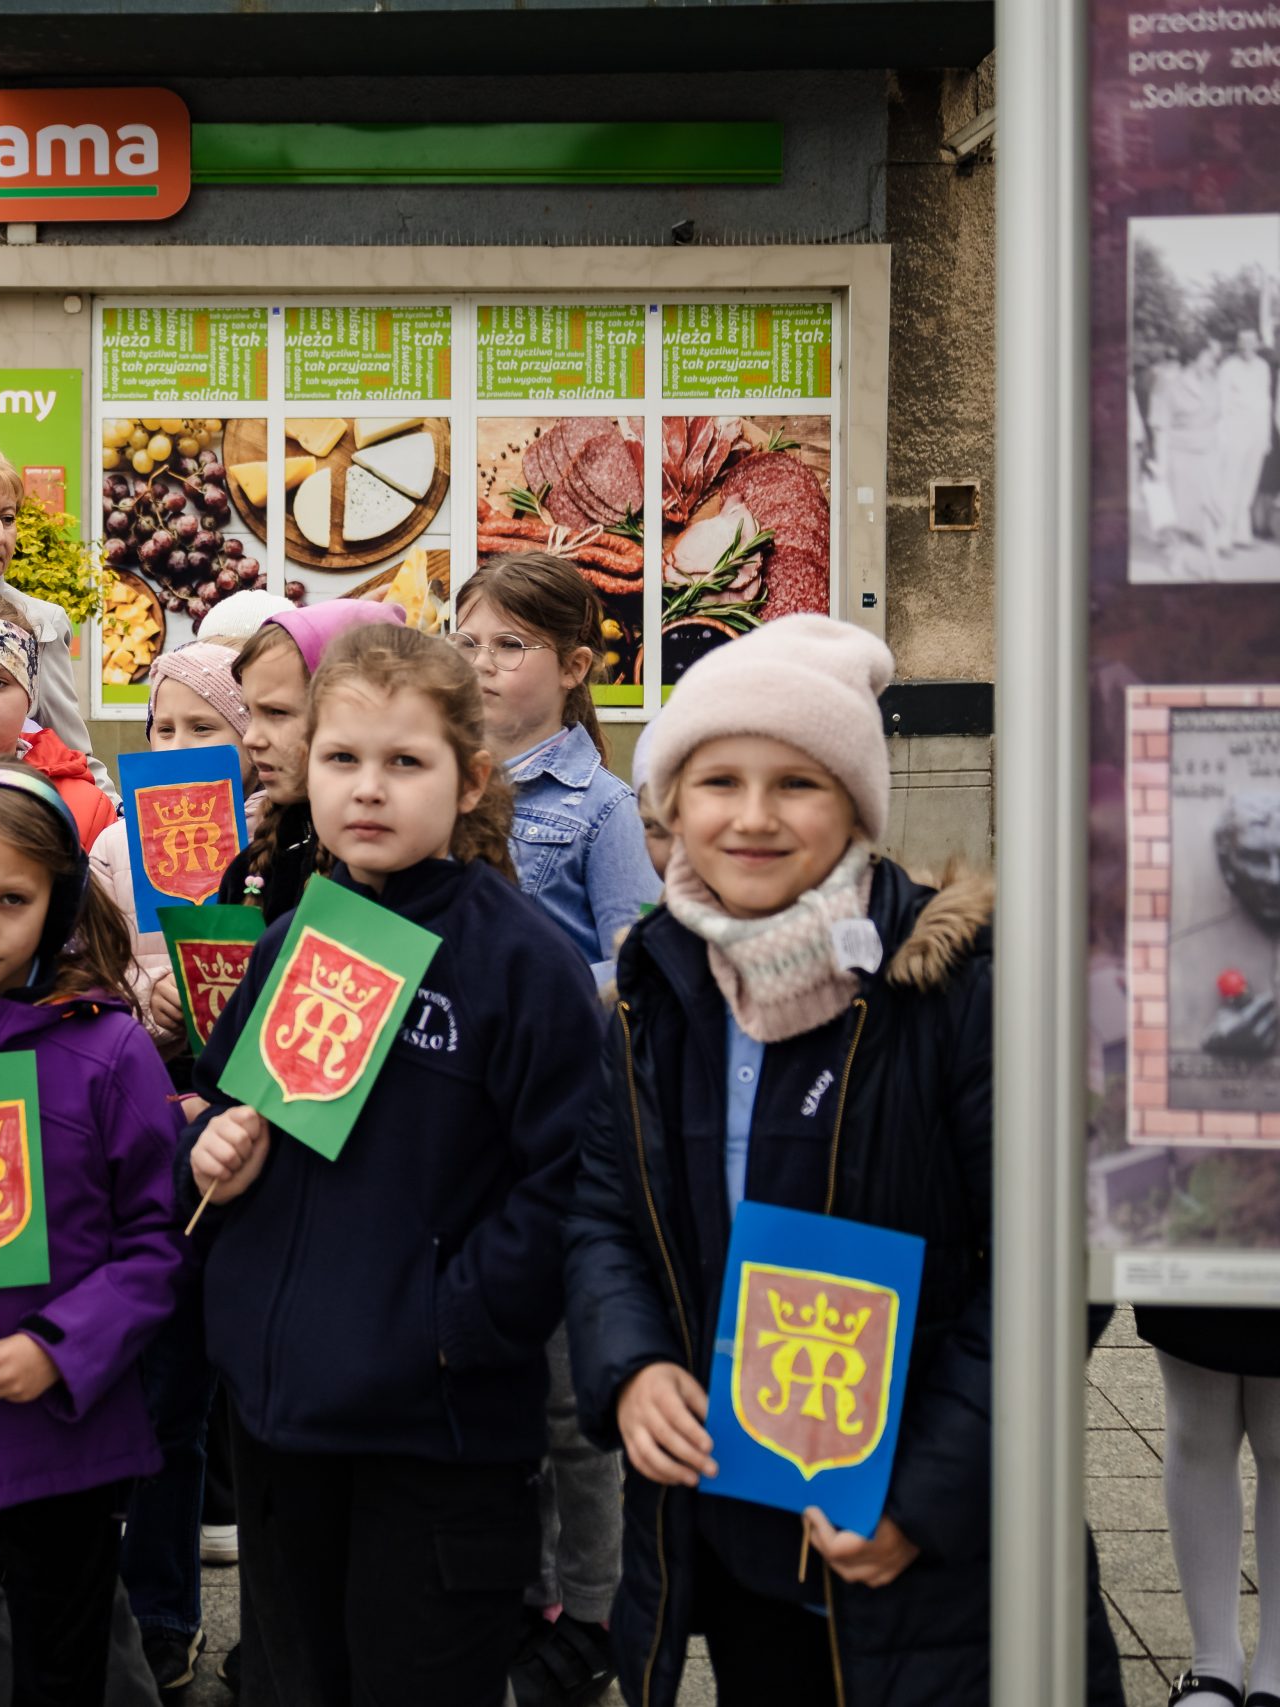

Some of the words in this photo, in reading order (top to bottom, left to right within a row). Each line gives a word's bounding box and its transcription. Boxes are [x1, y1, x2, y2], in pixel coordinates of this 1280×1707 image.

[1128, 48, 1211, 77] pracy
[122, 362, 142, 372] tak
[145, 361, 207, 374] przyjazna
[305, 361, 325, 372] tak
[328, 360, 390, 374] przyjazna
[497, 360, 517, 370] tak
[520, 359, 584, 372] przyjazna
[683, 359, 704, 369] tak
[707, 358, 770, 371] przyjazna
[153, 389, 178, 400] tak
[182, 388, 239, 400] solidna
[336, 388, 361, 400] tak
[365, 388, 422, 400] solidna
[529, 388, 554, 399] tak
[558, 387, 616, 399] solidna
[715, 386, 740, 398] tak
[745, 385, 802, 398] solidna
